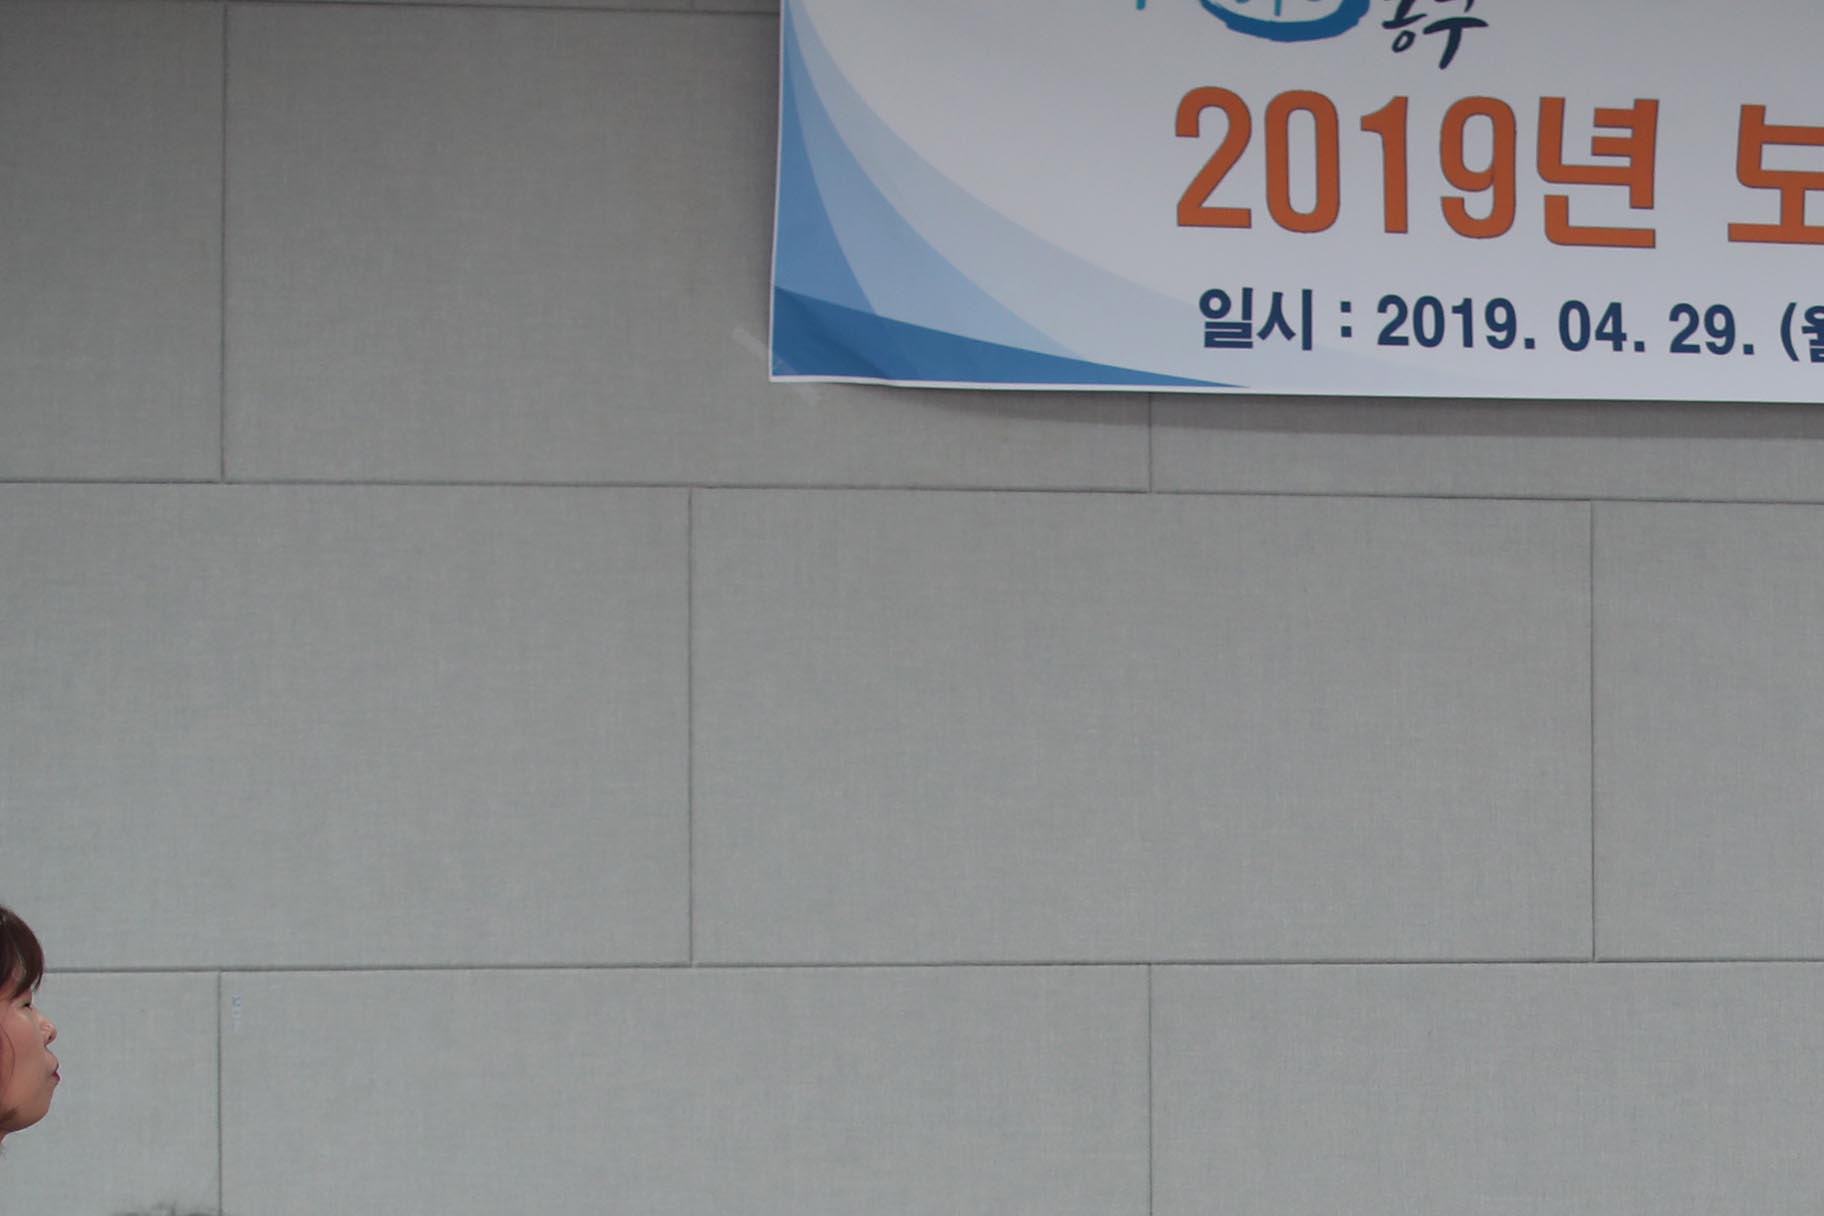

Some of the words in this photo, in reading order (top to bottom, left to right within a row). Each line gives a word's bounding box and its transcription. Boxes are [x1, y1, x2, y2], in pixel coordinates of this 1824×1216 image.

[1175, 86, 1660, 249] 2019년
[1198, 287, 1313, 351] 일시
[1377, 294, 1536, 350] 2019.
[1558, 299, 1645, 353] 04.
[1669, 302, 1755, 356] 29.
